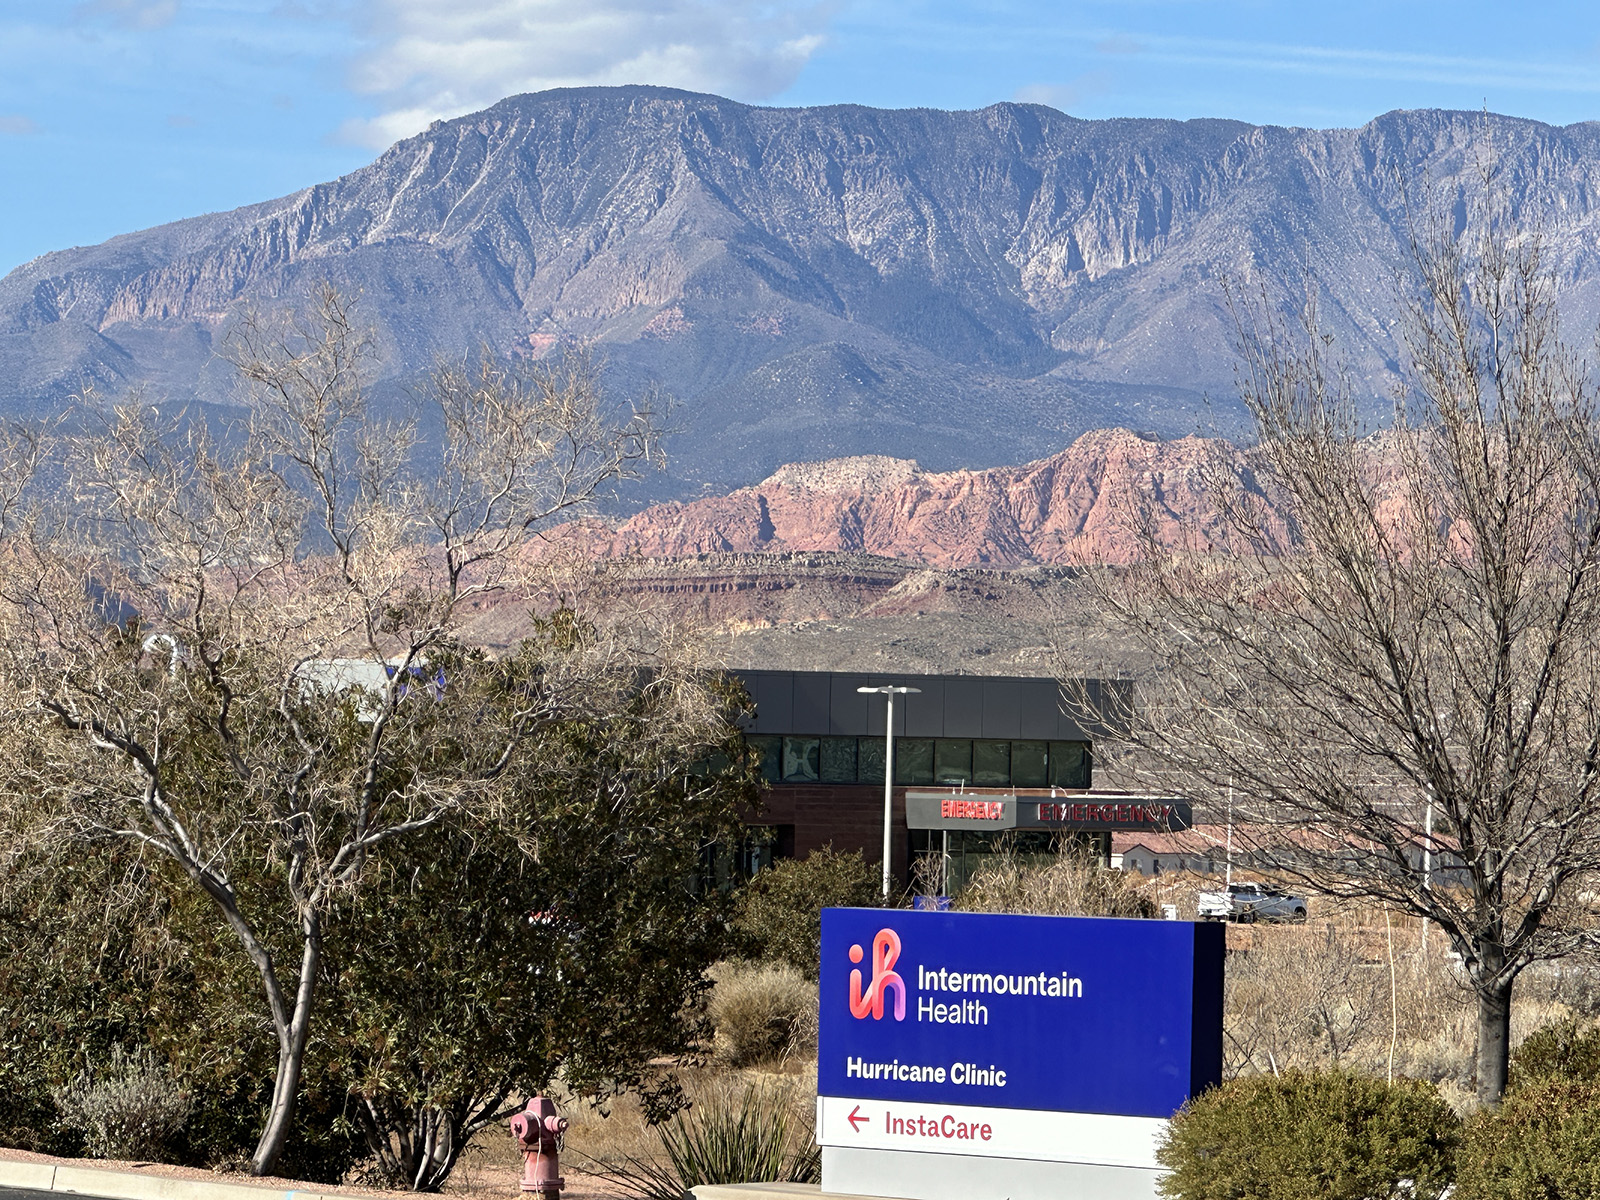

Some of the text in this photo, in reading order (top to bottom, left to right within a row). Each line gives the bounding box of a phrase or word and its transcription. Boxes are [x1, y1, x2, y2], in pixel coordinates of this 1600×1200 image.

[941, 800, 1004, 819] EMERGENCY
[1038, 803, 1171, 822] EMERGENCY
[918, 964, 1083, 998] Intermountain
[917, 997, 988, 1025] Health
[846, 1056, 1007, 1087] Hurricane Clinic
[885, 1111, 992, 1141] InstaCare
